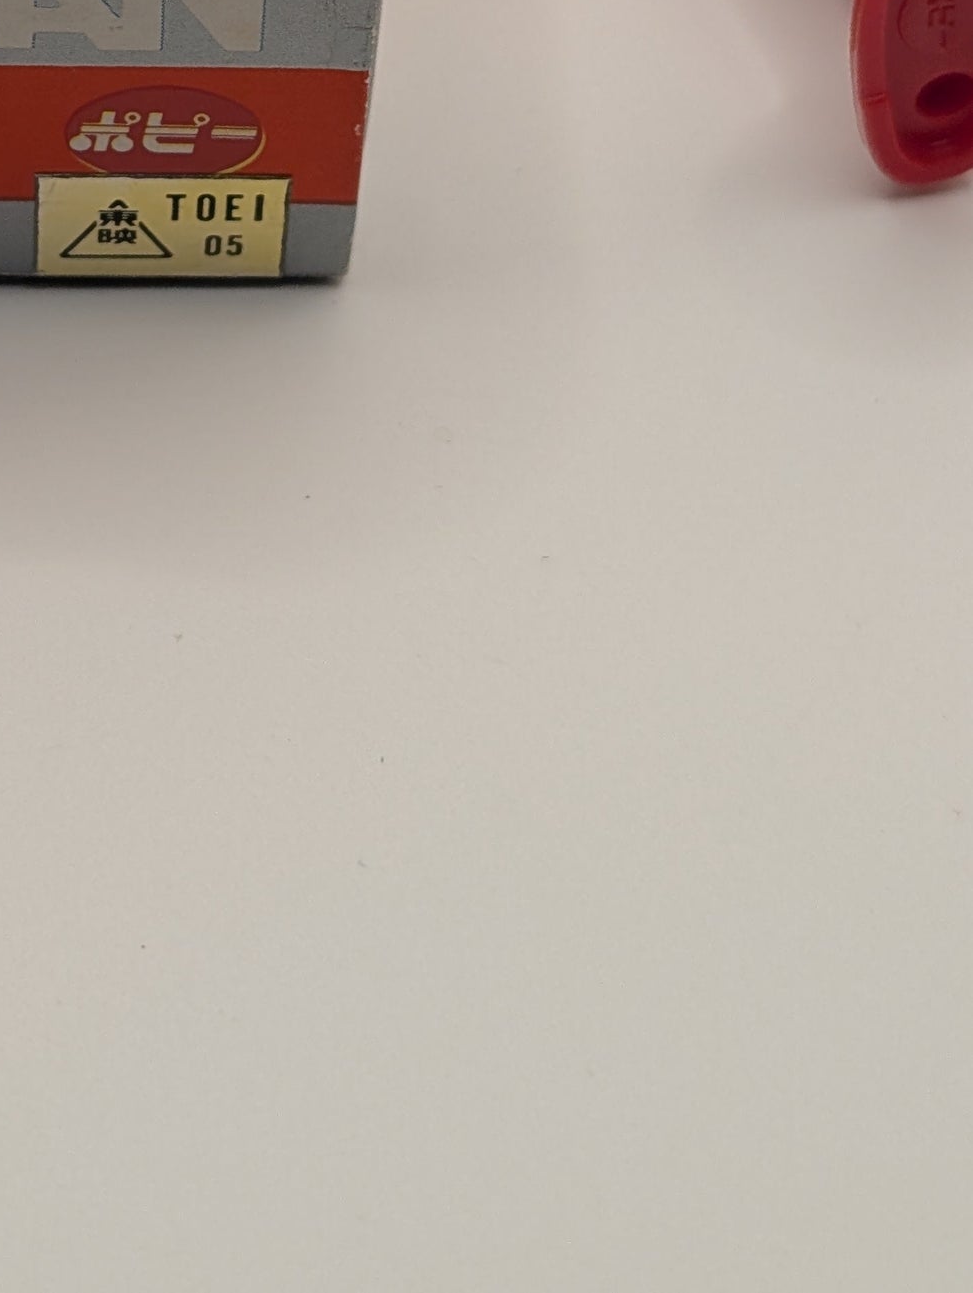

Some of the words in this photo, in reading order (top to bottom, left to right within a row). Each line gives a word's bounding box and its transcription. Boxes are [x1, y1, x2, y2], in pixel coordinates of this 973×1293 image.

[68, 110, 258, 154] ポピー
[165, 193, 265, 222] TOEI
[203, 234, 244, 257] 05
